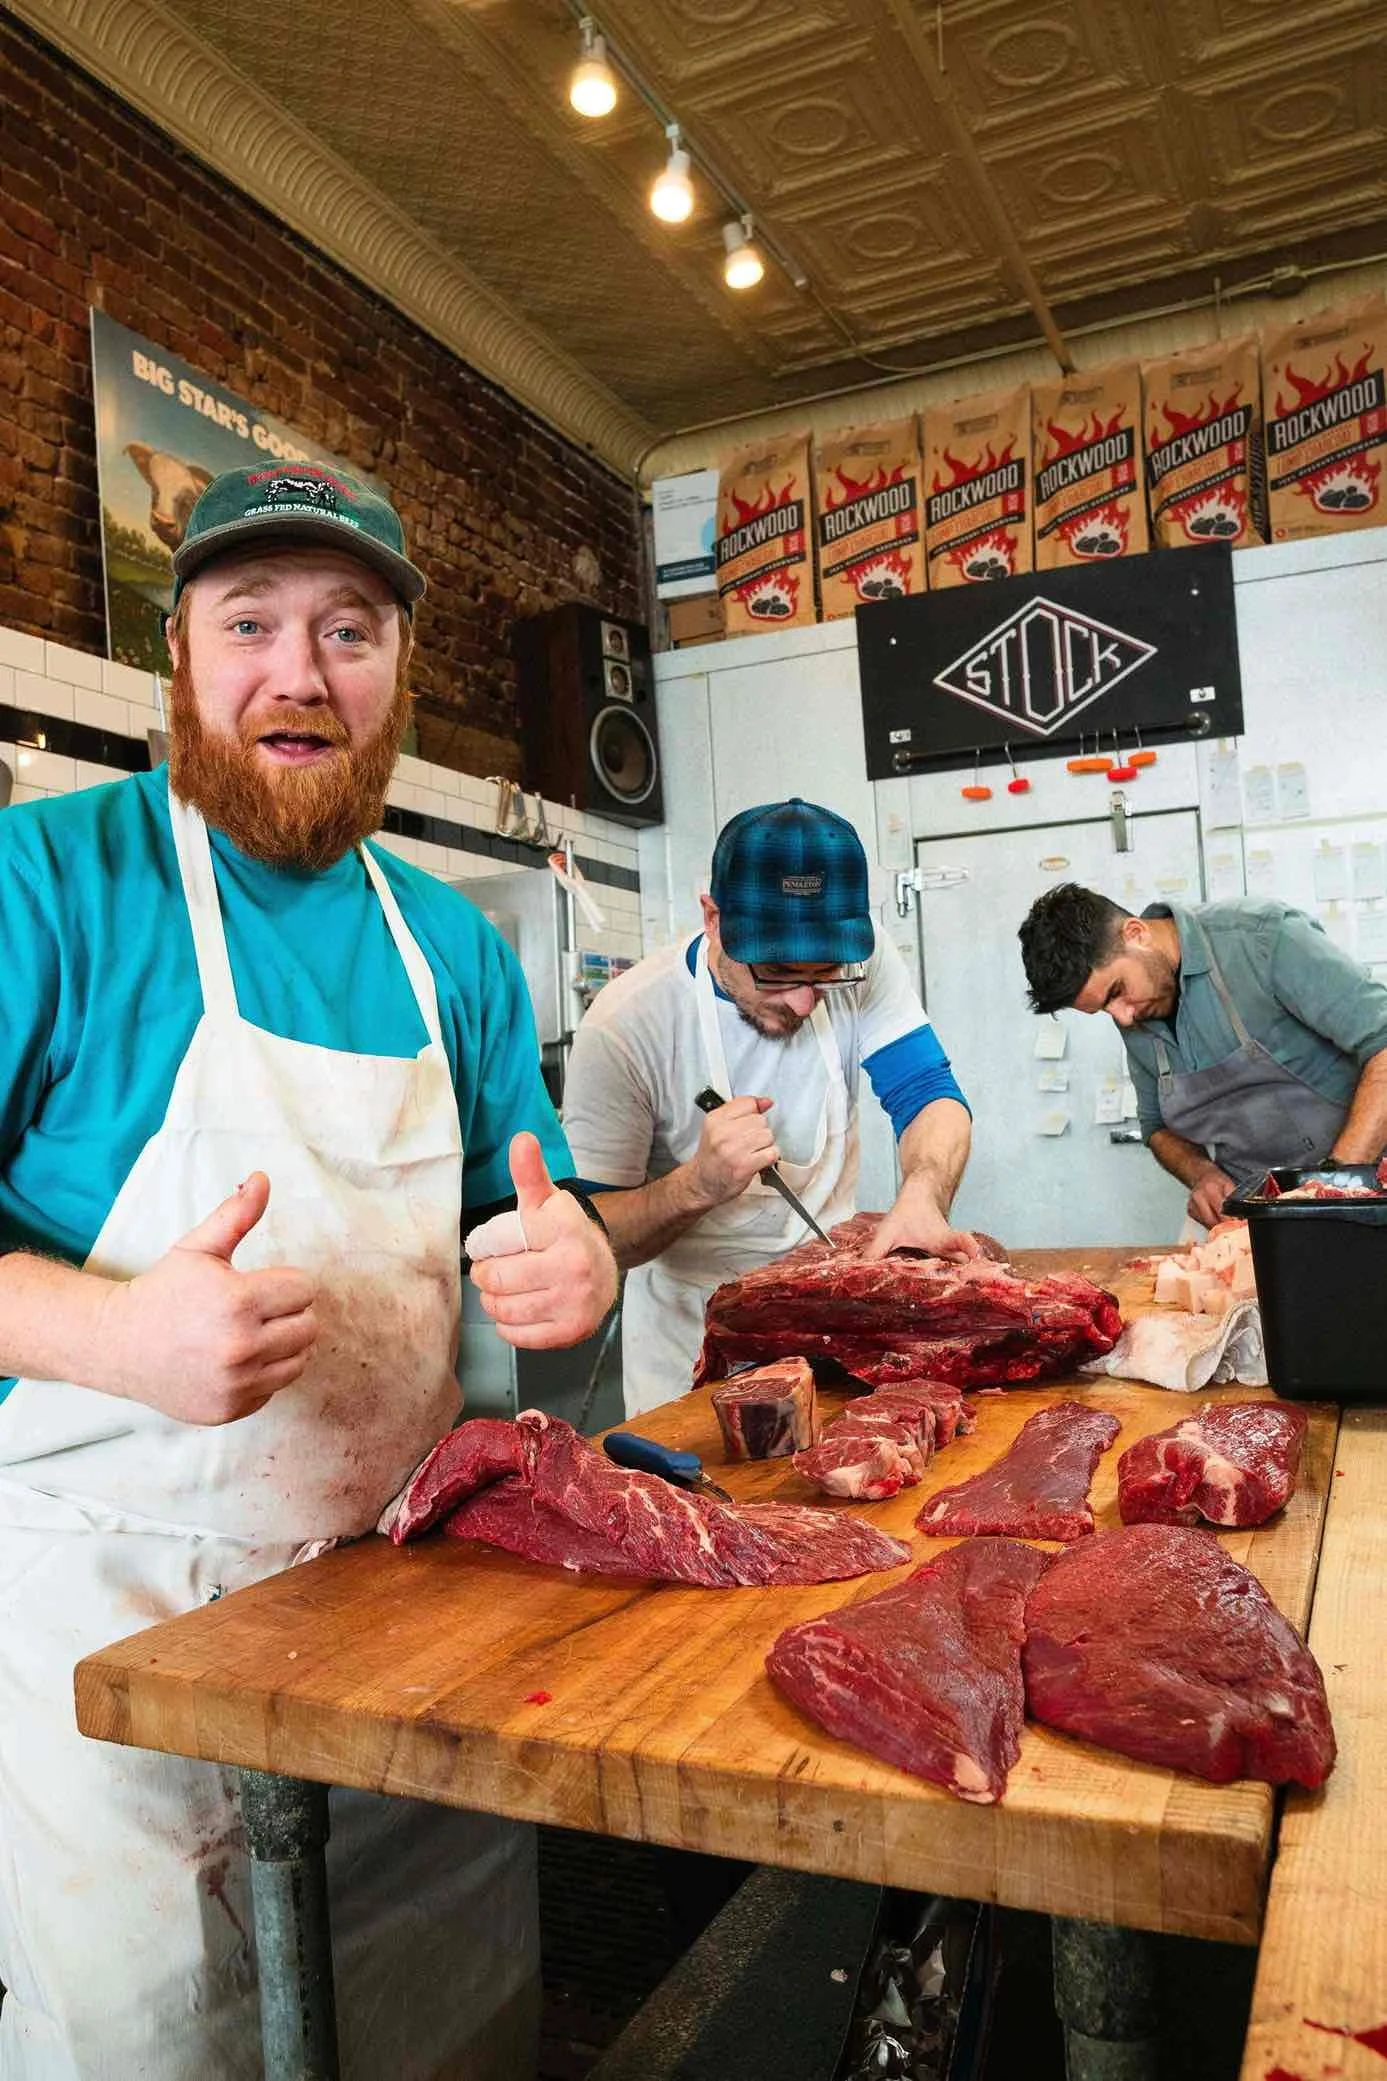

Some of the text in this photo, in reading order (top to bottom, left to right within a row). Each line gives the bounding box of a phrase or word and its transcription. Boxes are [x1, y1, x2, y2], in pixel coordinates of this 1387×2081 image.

[132, 350, 175, 395] BIG
[178, 379, 249, 439] STAR'S
[1274, 378, 1377, 450] ROCKWOOD
[1040, 433, 1128, 500] ROCKWOOD
[1151, 411, 1244, 481] ROCKWOOD
[244, 503, 273, 517] GRASS
[274, 503, 293, 512] FED
[293, 503, 339, 520] NATURAL
[825, 484, 910, 540] ROCKWOOD
[930, 464, 1018, 522] ROCKWOOD
[720, 505, 798, 562] ROCKWOOD
[965, 607, 1121, 722] STOCK
